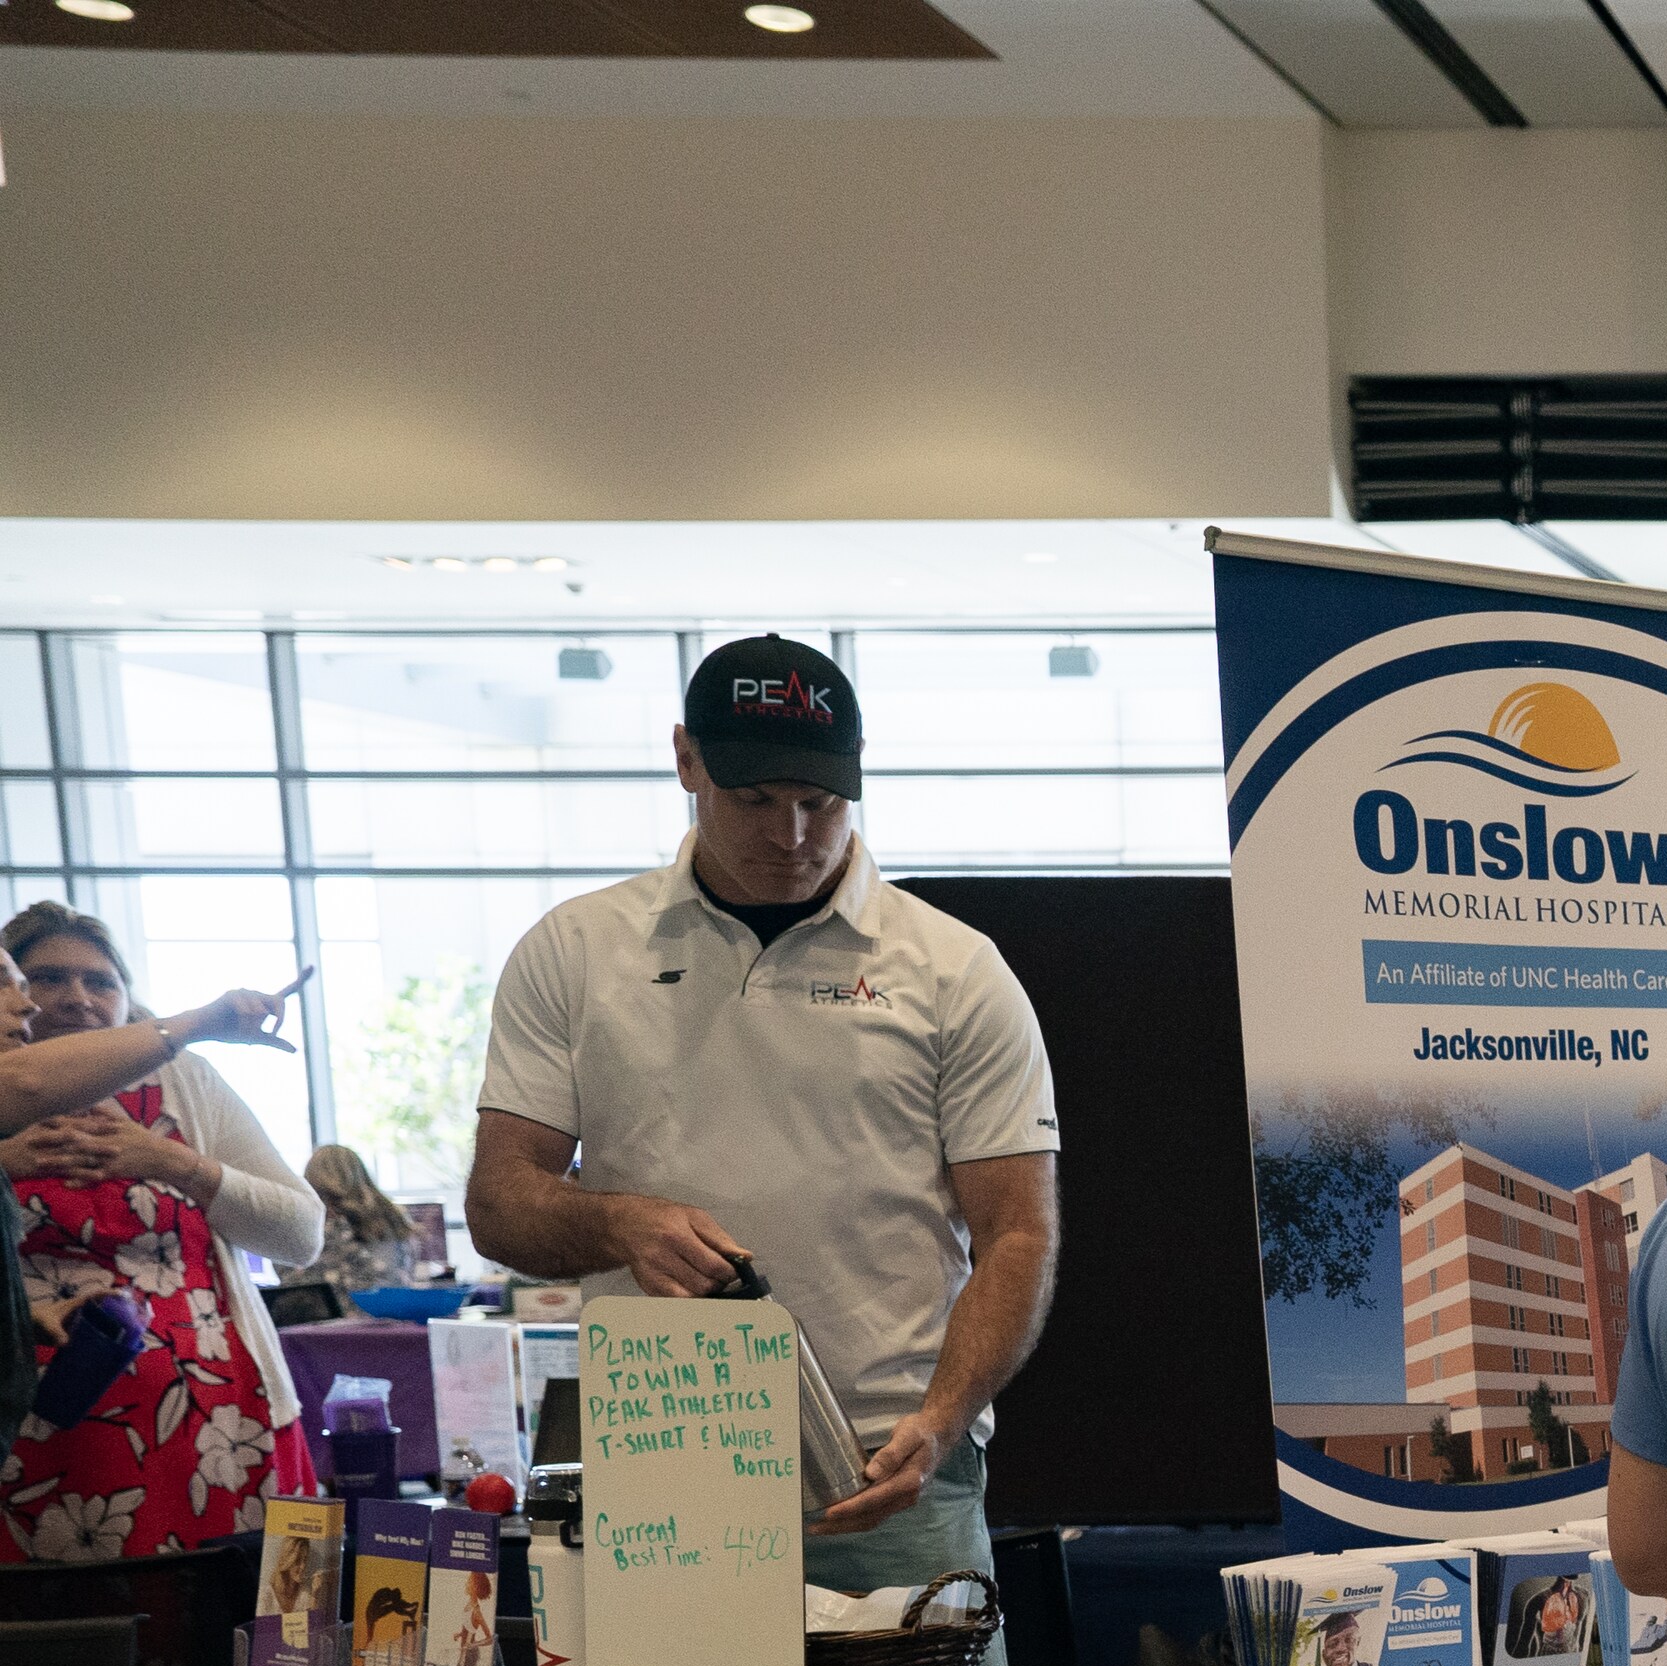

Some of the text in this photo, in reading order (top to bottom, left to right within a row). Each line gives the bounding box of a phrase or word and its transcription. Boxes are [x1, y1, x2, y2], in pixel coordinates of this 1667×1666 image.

[733, 670, 833, 713] PEAK
[734, 704, 834, 725] ATHLETICS
[1363, 888, 1528, 922] MEMORIAL
[811, 975, 891, 1001] PEAK
[1376, 961, 1404, 984] An
[1410, 962, 1485, 987] Affiliate
[1490, 966, 1507, 987] of
[1512, 967, 1557, 988] UNC
[1564, 969, 1628, 991] Health
[1413, 1027, 1650, 1068] Jacksonville, NC
[588, 1324, 673, 1365] PLANK
[694, 1332, 732, 1360] FOR
[734, 1323, 793, 1364] TIME
[713, 1362, 731, 1387] A
[589, 1389, 772, 1427] PEAK ATHLETICS
[596, 1425, 686, 1459] T-SHIRT
[718, 1422, 775, 1450] WATER
[733, 1453, 794, 1478] BOTTLE
[595, 1512, 678, 1548] Current
[614, 1546, 657, 1571] Best
[1343, 1585, 1383, 1598] Onslow
[1390, 1602, 1462, 1624] Onslow
